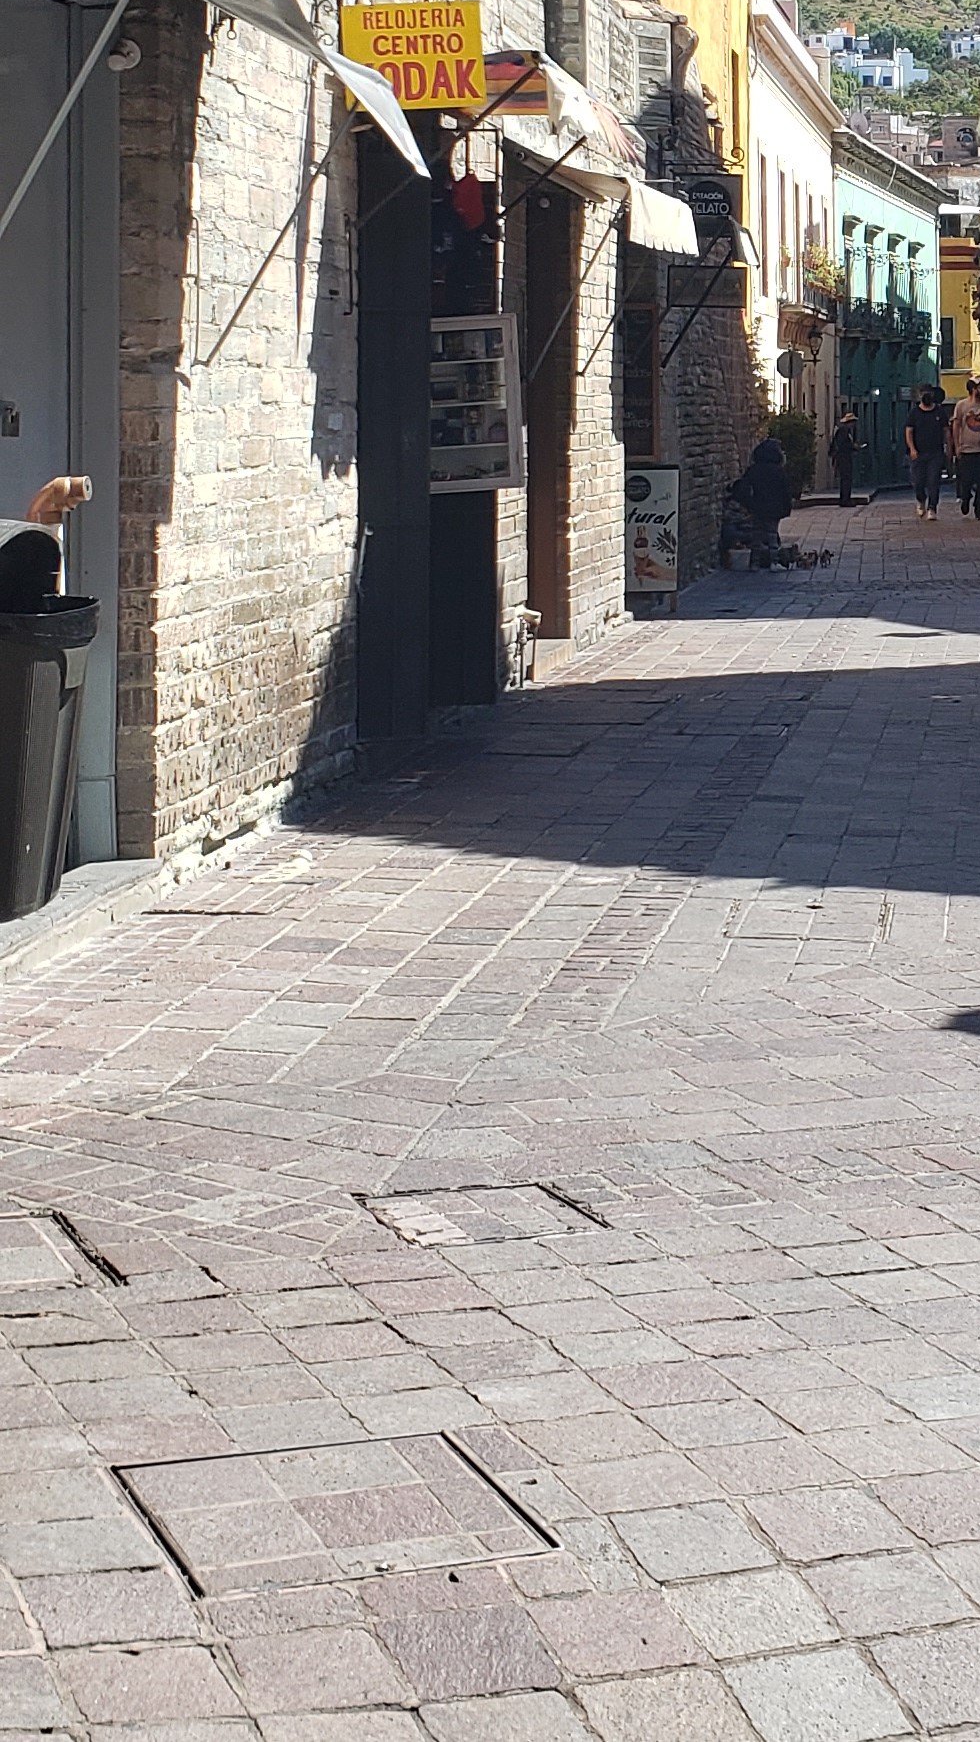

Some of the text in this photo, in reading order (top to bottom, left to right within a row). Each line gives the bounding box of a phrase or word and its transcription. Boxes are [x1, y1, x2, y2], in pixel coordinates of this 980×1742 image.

[362, 8, 465, 30] RELOJERIA
[372, 33, 464, 56] CENTRO
[365, 59, 482, 101] ODAK
[627, 507, 676, 525] tural
